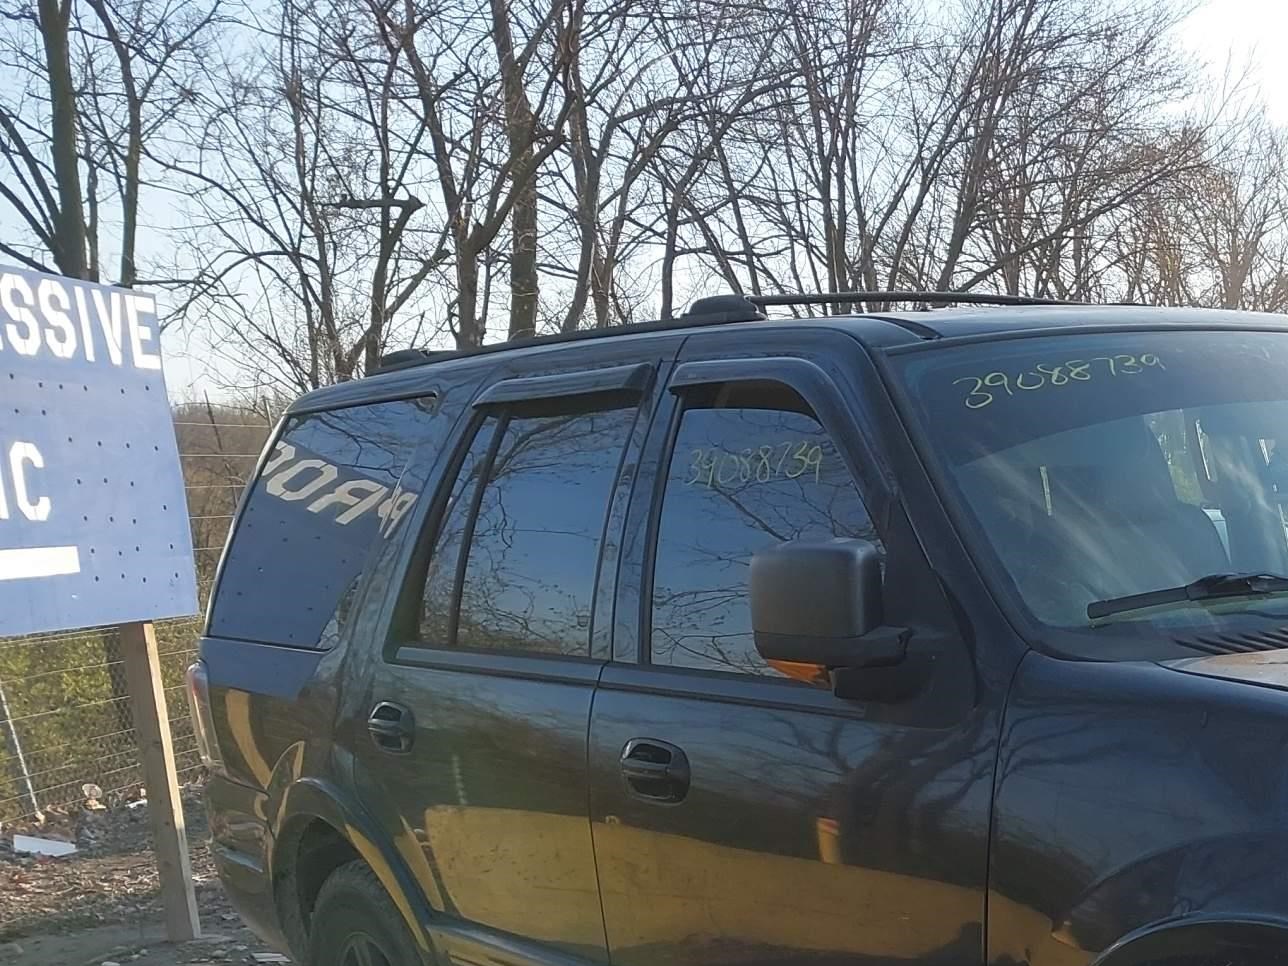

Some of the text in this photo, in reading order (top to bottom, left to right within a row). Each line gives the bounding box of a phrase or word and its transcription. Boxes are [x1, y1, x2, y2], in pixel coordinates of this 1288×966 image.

[0, 273, 161, 369] SSIVE
[952, 353, 1166, 409] 39088739
[684, 440, 823, 488] 39088739
